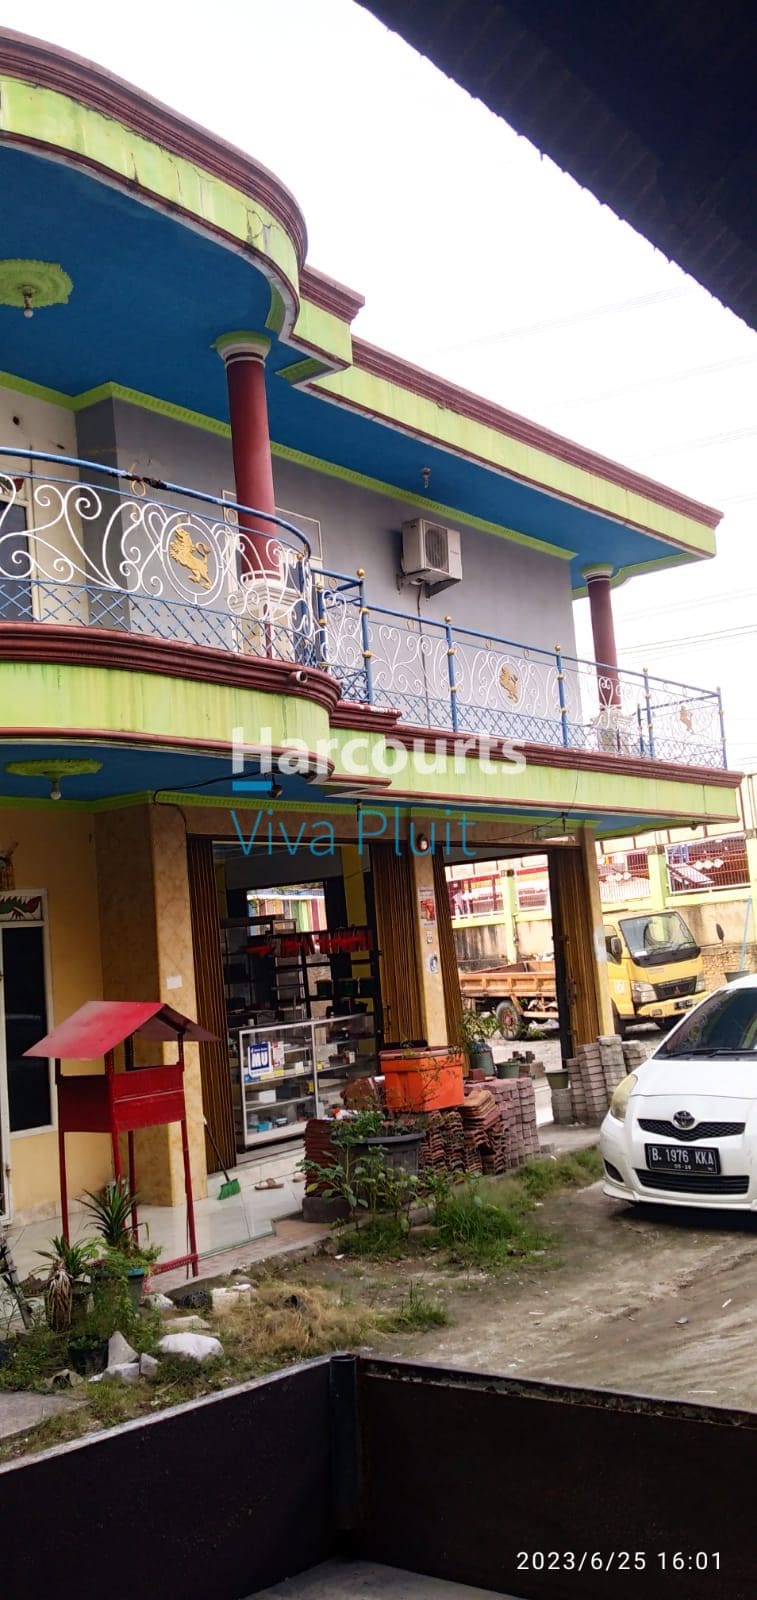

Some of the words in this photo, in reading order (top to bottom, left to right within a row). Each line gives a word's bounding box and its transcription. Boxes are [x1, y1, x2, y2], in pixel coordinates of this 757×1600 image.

[252, 1051, 268, 1068] MU
[665, 1149, 689, 1163] 1976
[695, 1152, 714, 1165] KKA
